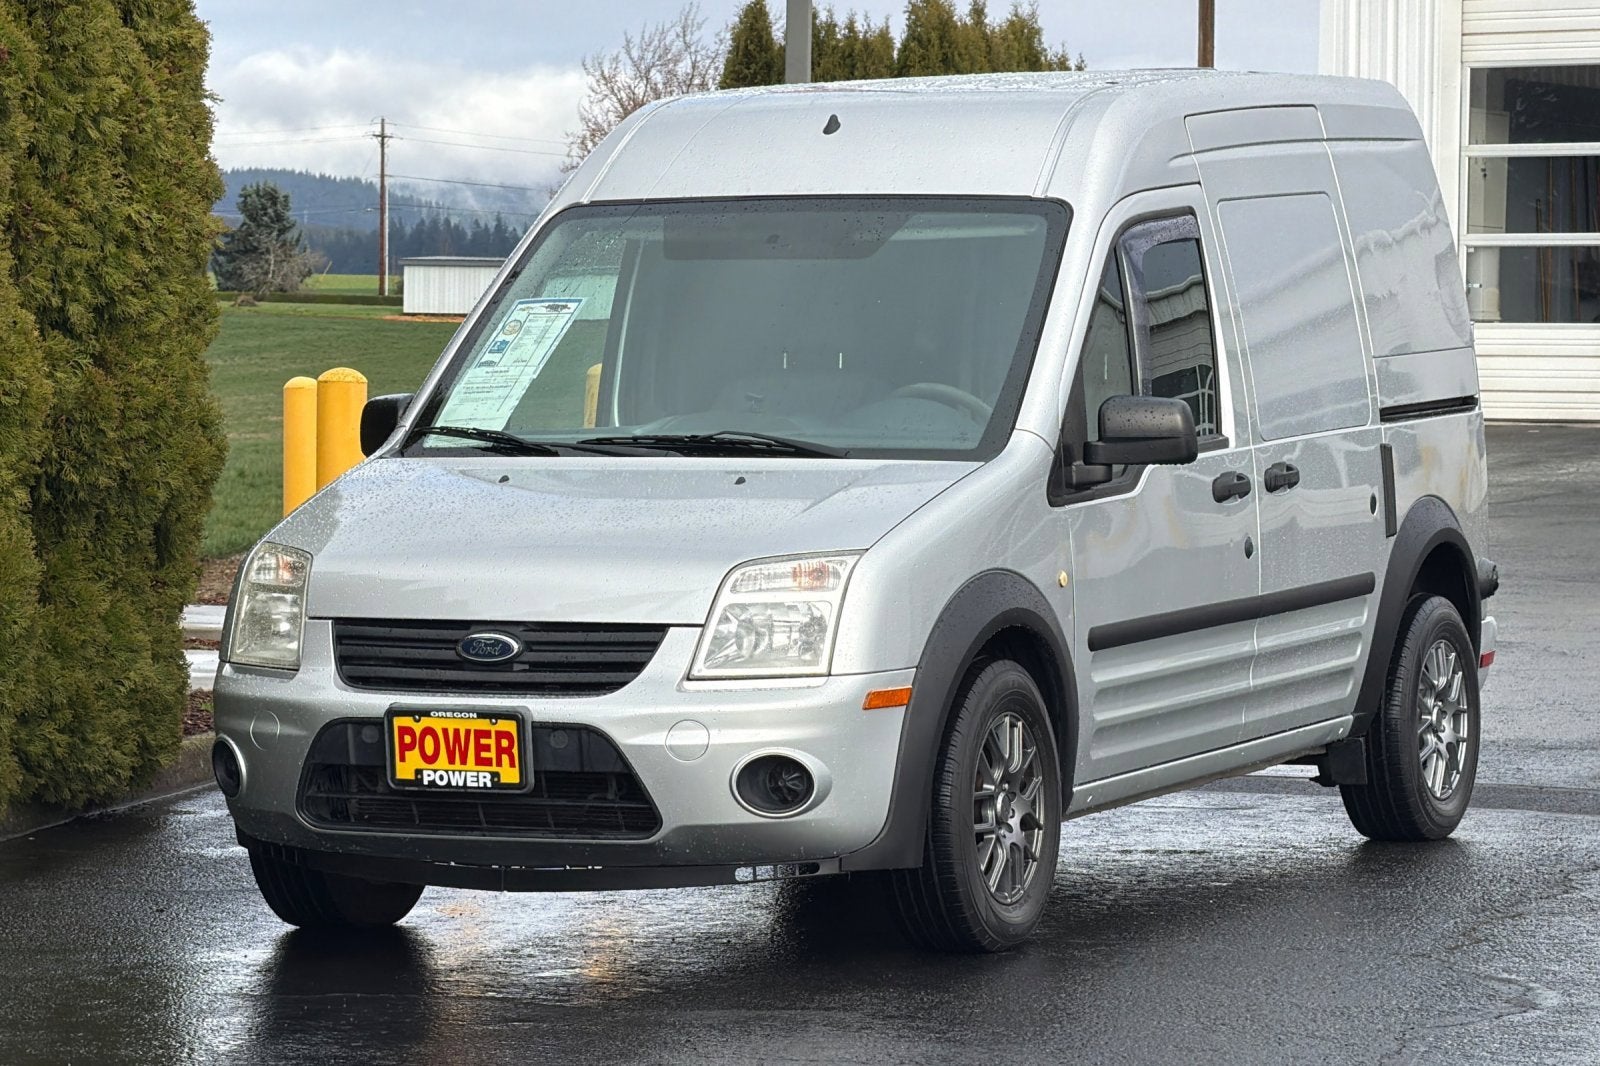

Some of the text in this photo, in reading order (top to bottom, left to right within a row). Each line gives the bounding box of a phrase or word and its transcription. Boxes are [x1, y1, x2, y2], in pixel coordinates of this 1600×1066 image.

[469, 638, 503, 656] Ford
[430, 711, 478, 719] OREGON
[397, 725, 517, 768] POWER
[422, 769, 492, 788] POWER
